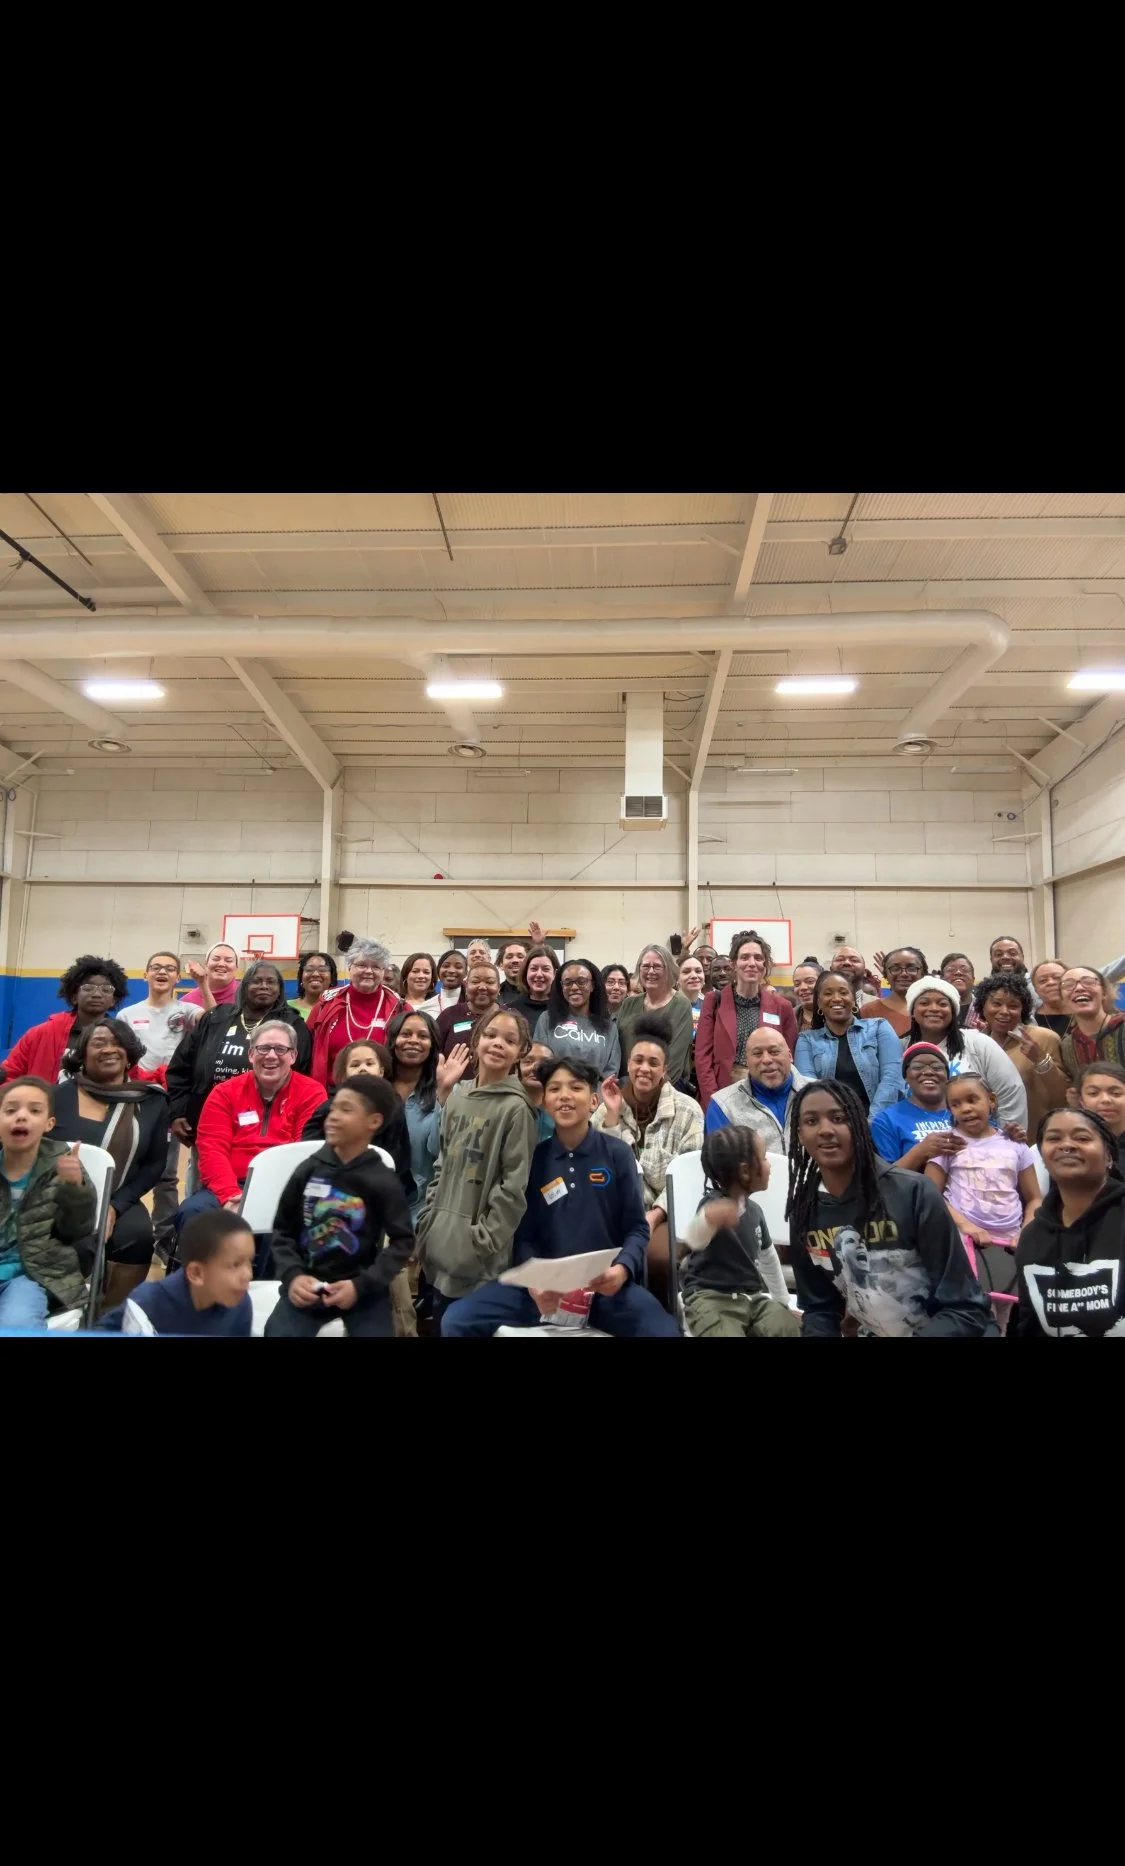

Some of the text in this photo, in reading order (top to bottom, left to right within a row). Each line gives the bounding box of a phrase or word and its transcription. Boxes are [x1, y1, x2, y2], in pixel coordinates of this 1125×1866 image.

[554, 1025, 606, 1047] Calvin
[222, 1041, 244, 1056] im
[215, 1067, 239, 1075] oving,
[1047, 1284, 1109, 1299] SOMEBODY'S
[1047, 1302, 1069, 1313] FINE
[1086, 1298, 1110, 1312] MOM
